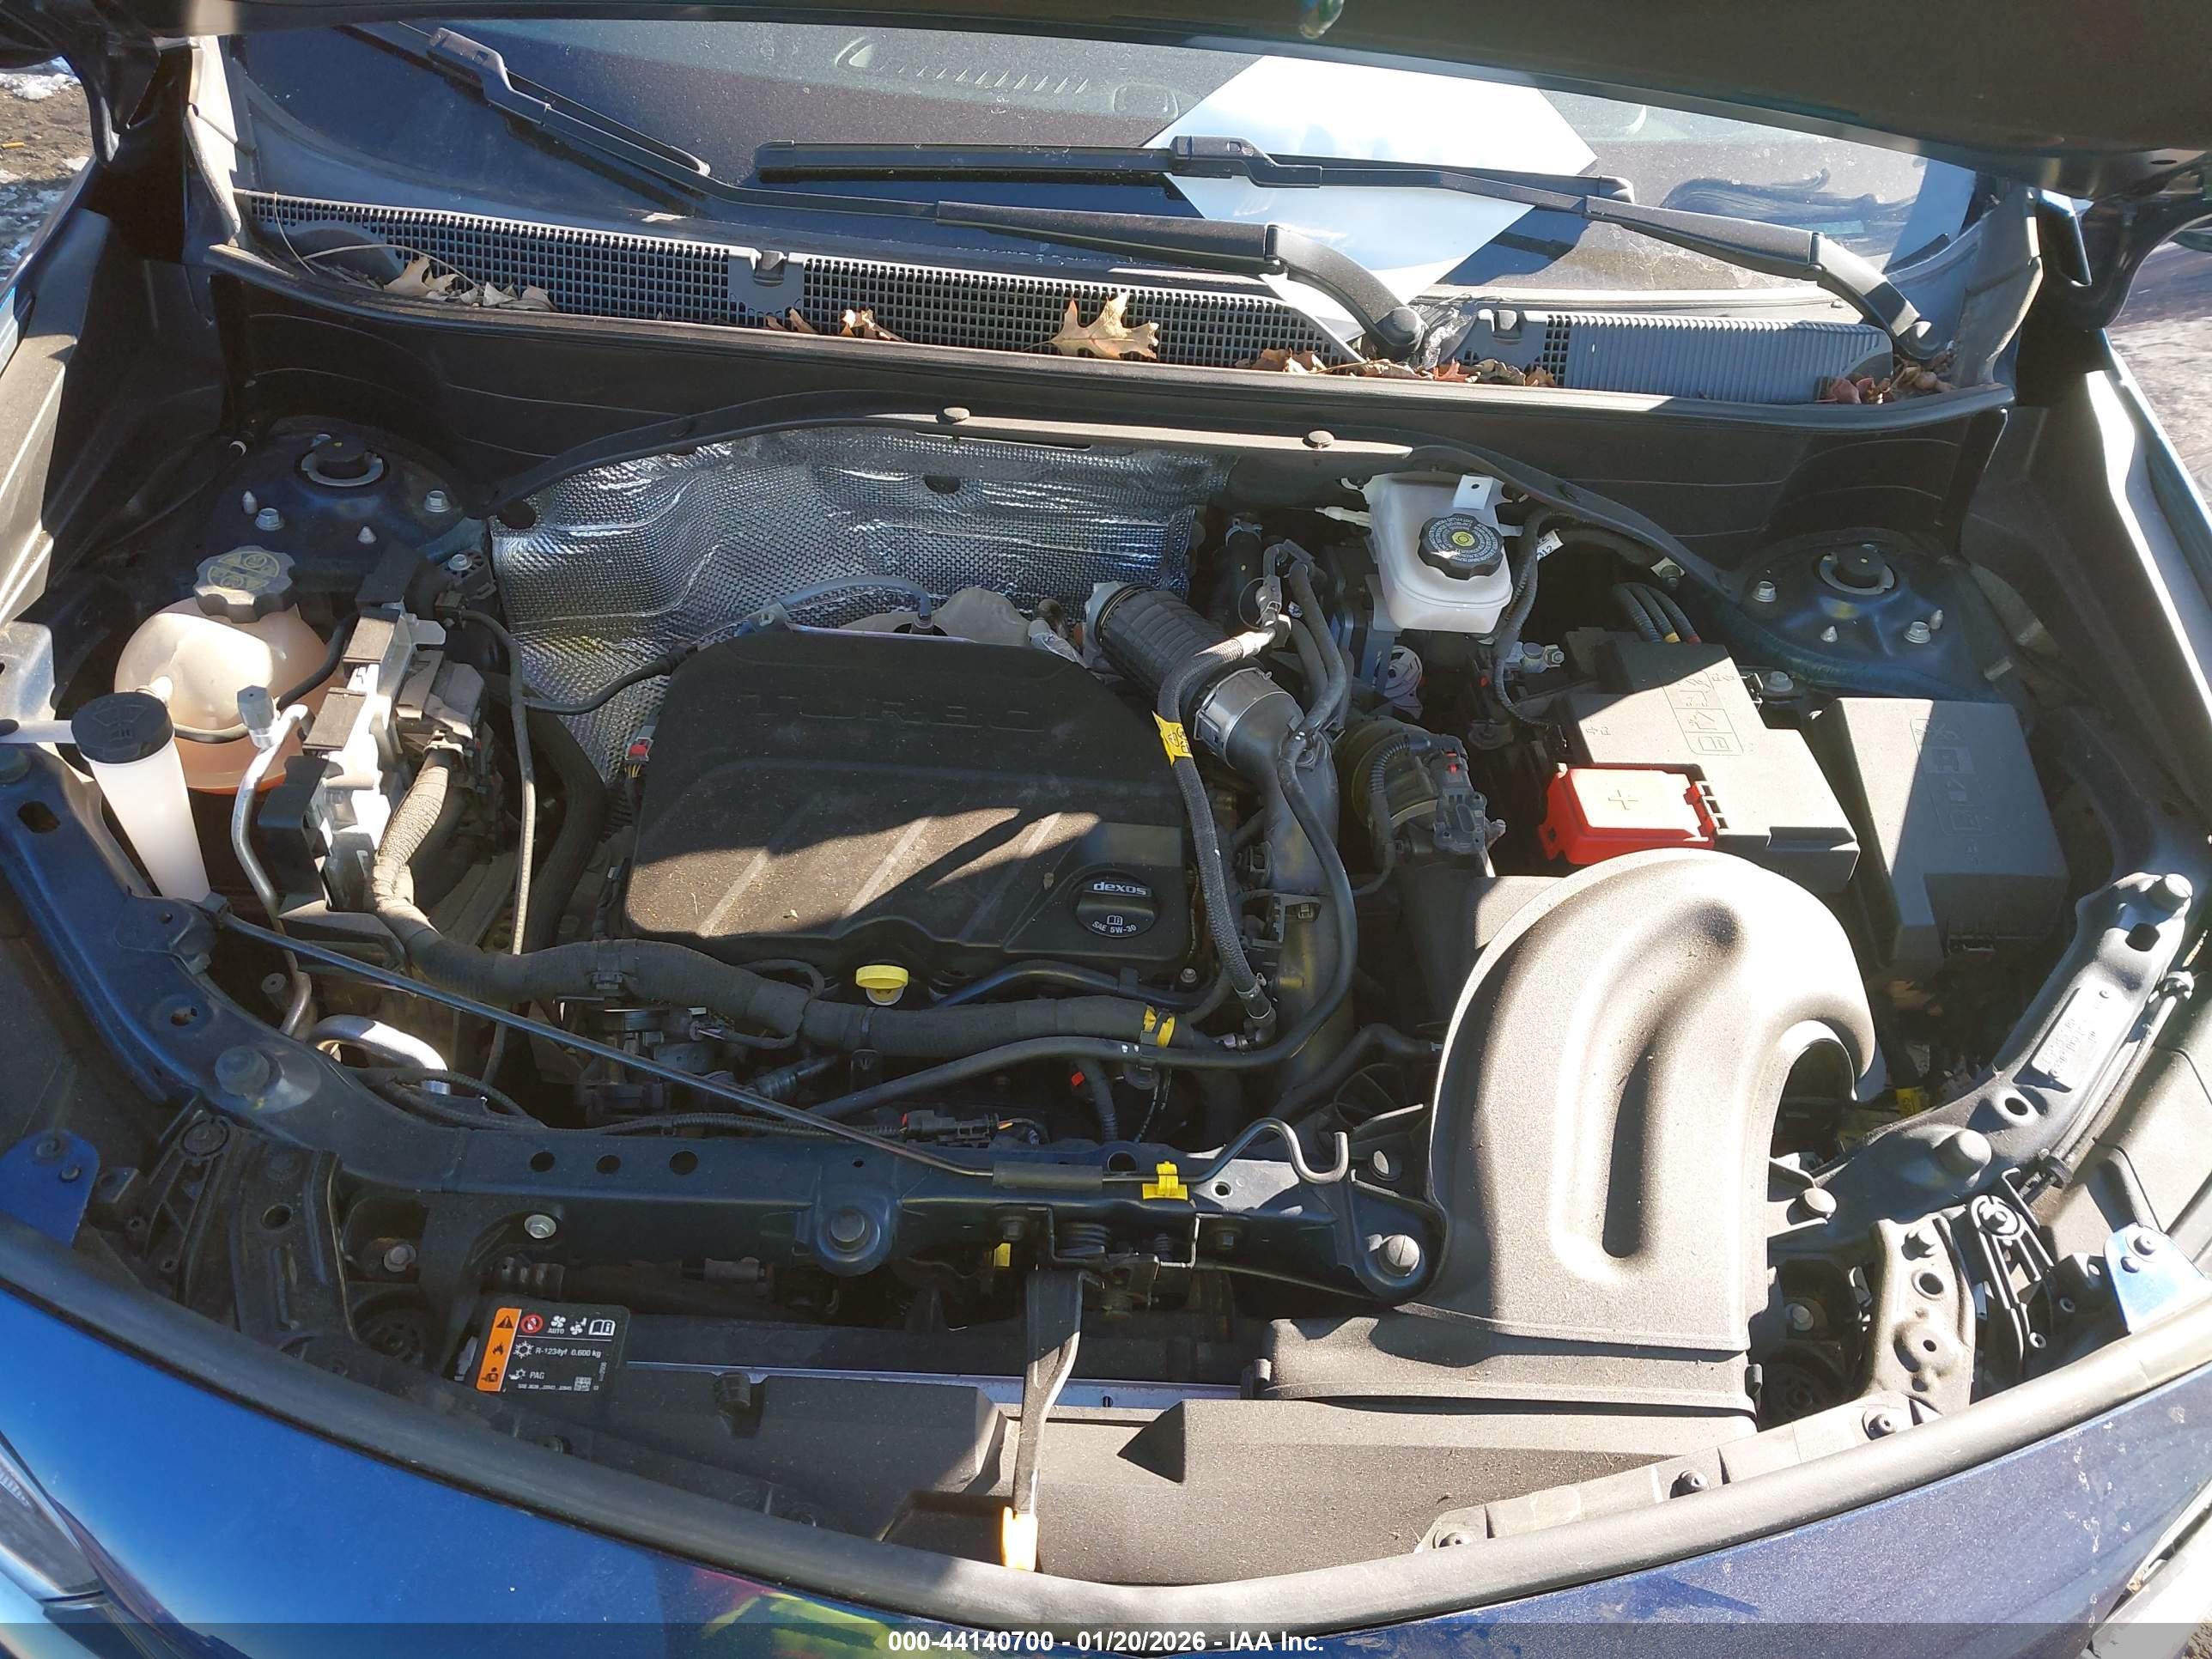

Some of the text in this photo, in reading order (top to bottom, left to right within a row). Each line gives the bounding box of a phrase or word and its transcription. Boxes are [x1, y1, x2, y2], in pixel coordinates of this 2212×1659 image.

[1093, 881, 1147, 896] dexos
[1091, 921, 1137, 933] SAE 5W-30
[535, 1346, 602, 1358] R-1234yf 0.600 kg
[529, 1370, 545, 1380] PAG
